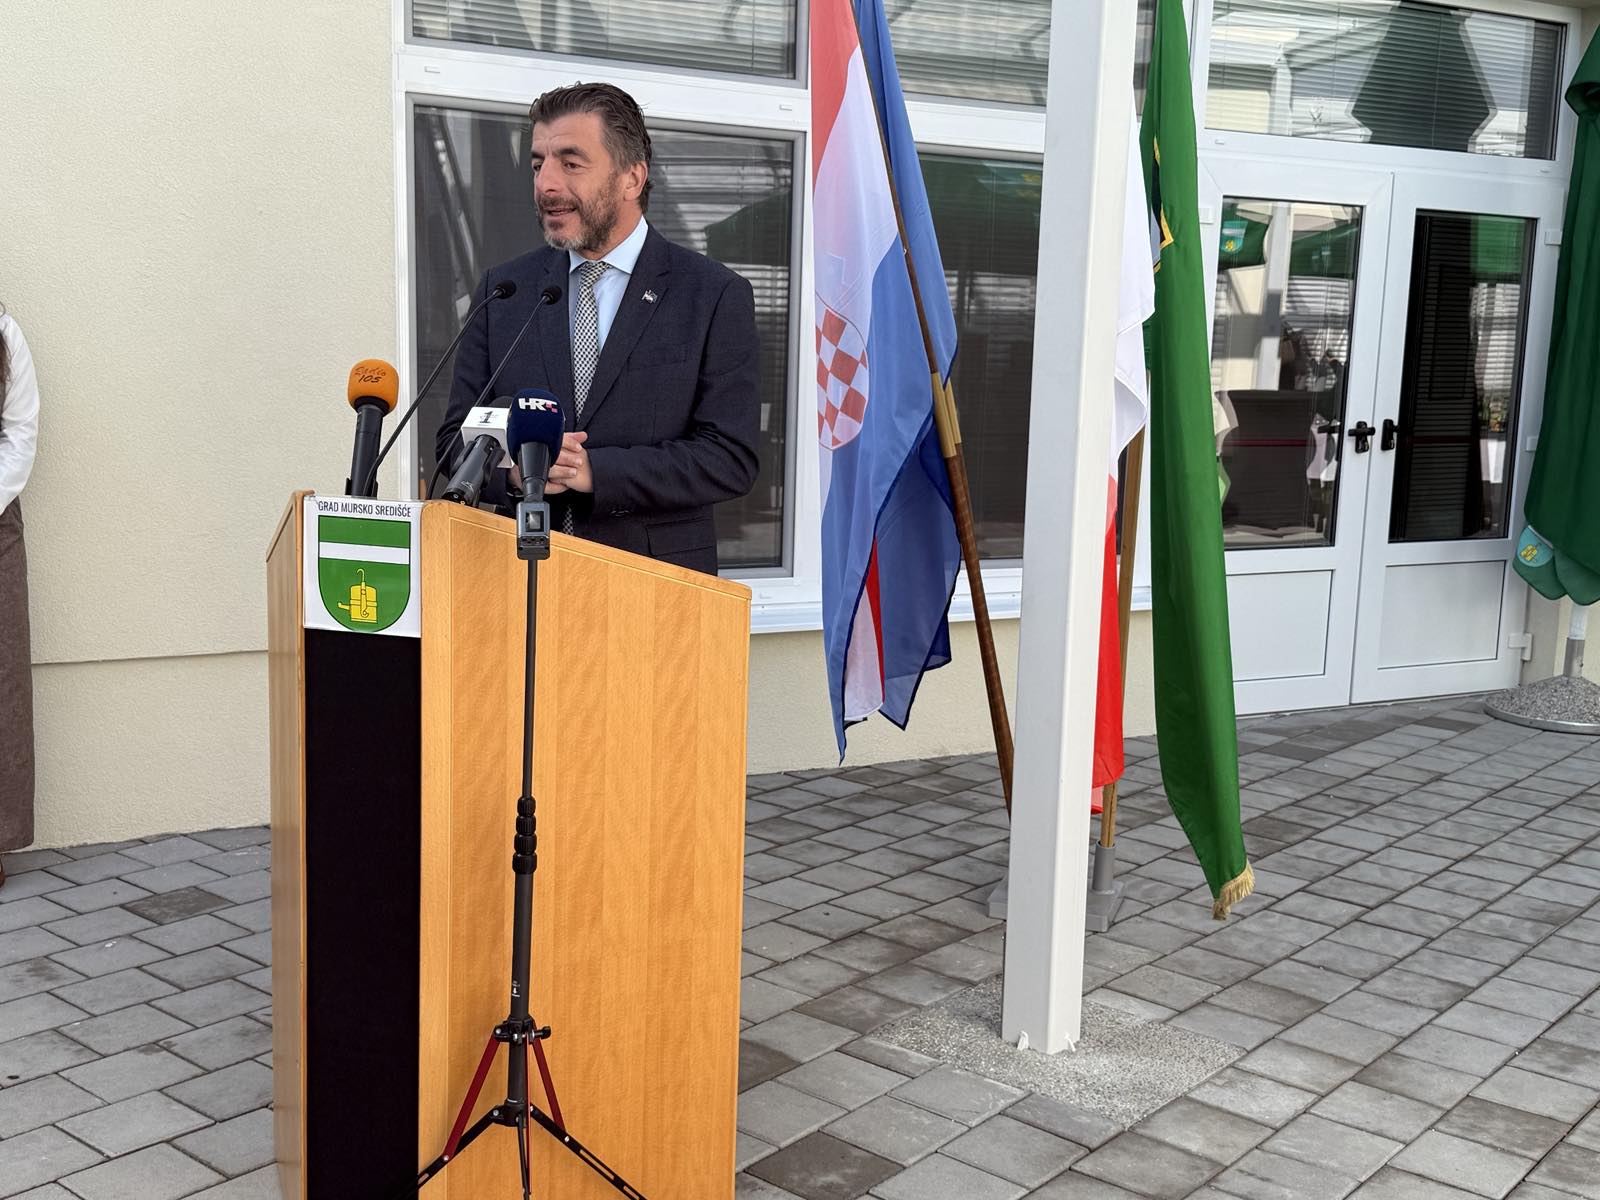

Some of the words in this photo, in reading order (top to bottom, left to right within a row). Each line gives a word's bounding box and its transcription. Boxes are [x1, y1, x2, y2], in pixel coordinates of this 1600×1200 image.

[358, 374, 382, 383] 105
[318, 500, 339, 512] GRAD
[340, 502, 373, 515] MURSKO
[375, 504, 412, 518] SREDIŠĆE
